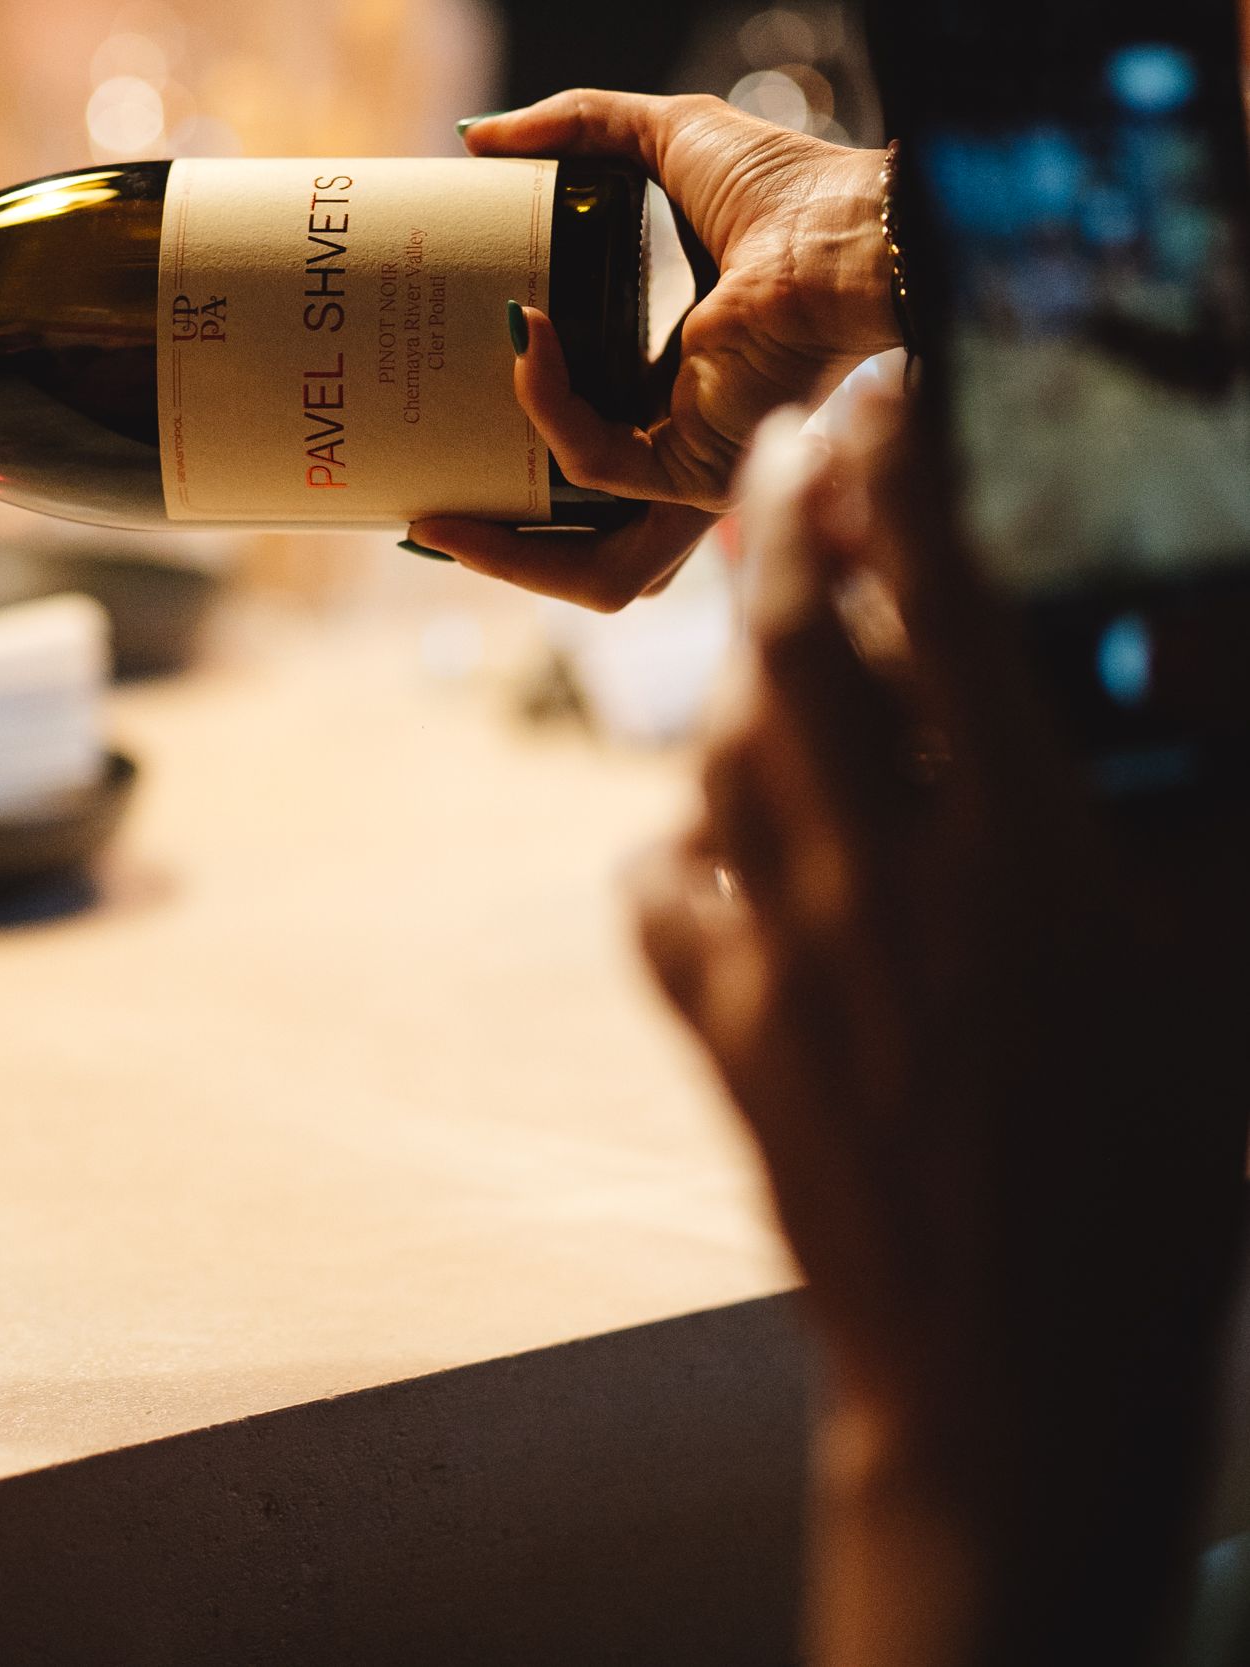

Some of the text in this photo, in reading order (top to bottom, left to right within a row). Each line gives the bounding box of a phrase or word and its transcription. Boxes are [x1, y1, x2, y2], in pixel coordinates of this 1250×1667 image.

[378, 261, 399, 385] PINOT NOIR
[527, 271, 537, 308] RY.RU
[302, 175, 353, 489] PAVEL SHVETS
[403, 227, 428, 425] Chernaya River Valley
[428, 331, 445, 371] Cler
[173, 413, 186, 484] SEVASTOPOL
[526, 447, 537, 486] CRIMEA
